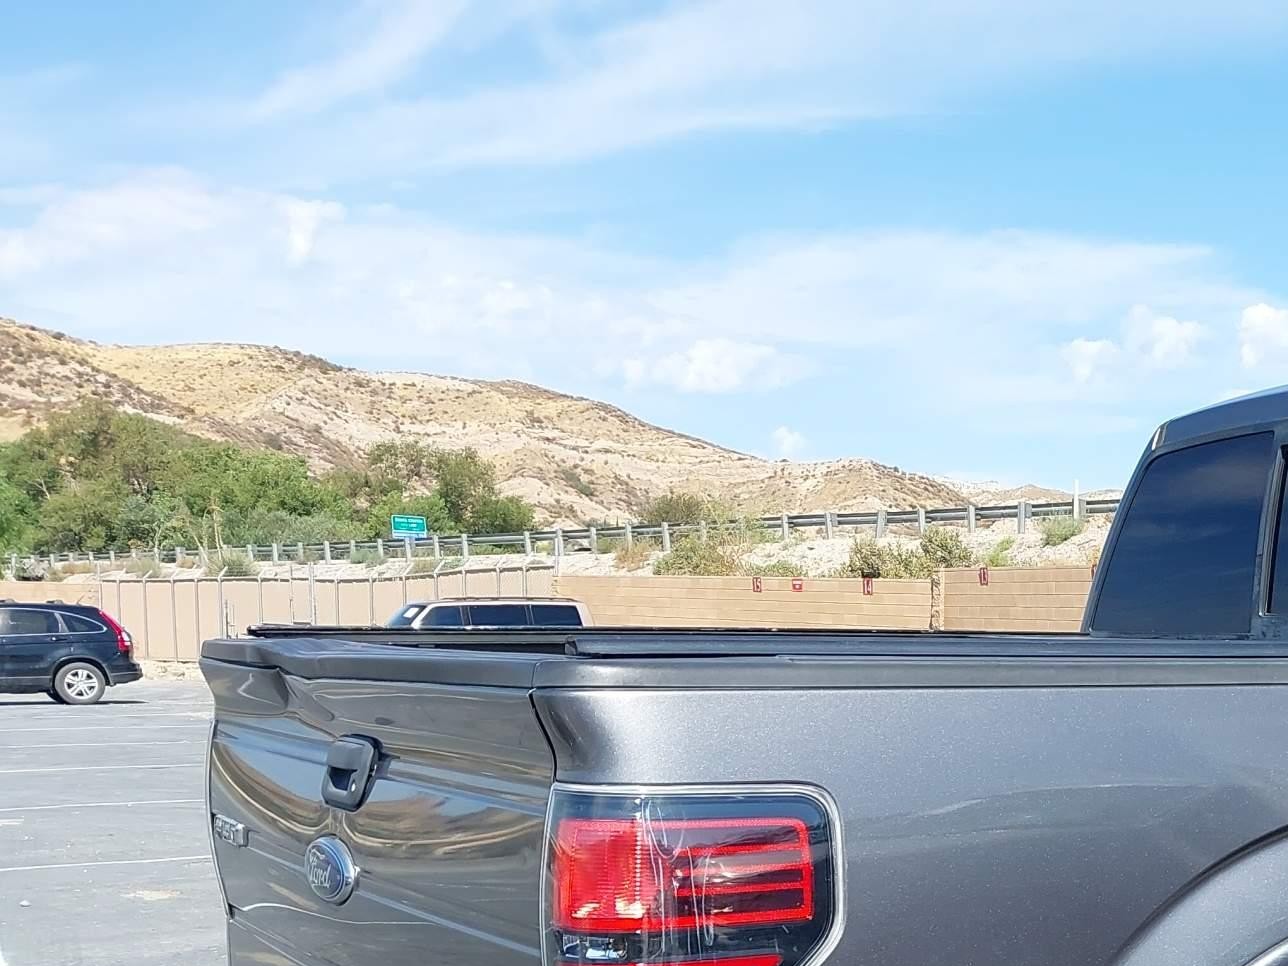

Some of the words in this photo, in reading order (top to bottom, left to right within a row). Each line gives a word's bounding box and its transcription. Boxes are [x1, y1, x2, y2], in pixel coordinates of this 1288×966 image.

[754, 578, 761, 591] 15
[864, 579, 872, 593] 14
[309, 849, 332, 889] Ford
